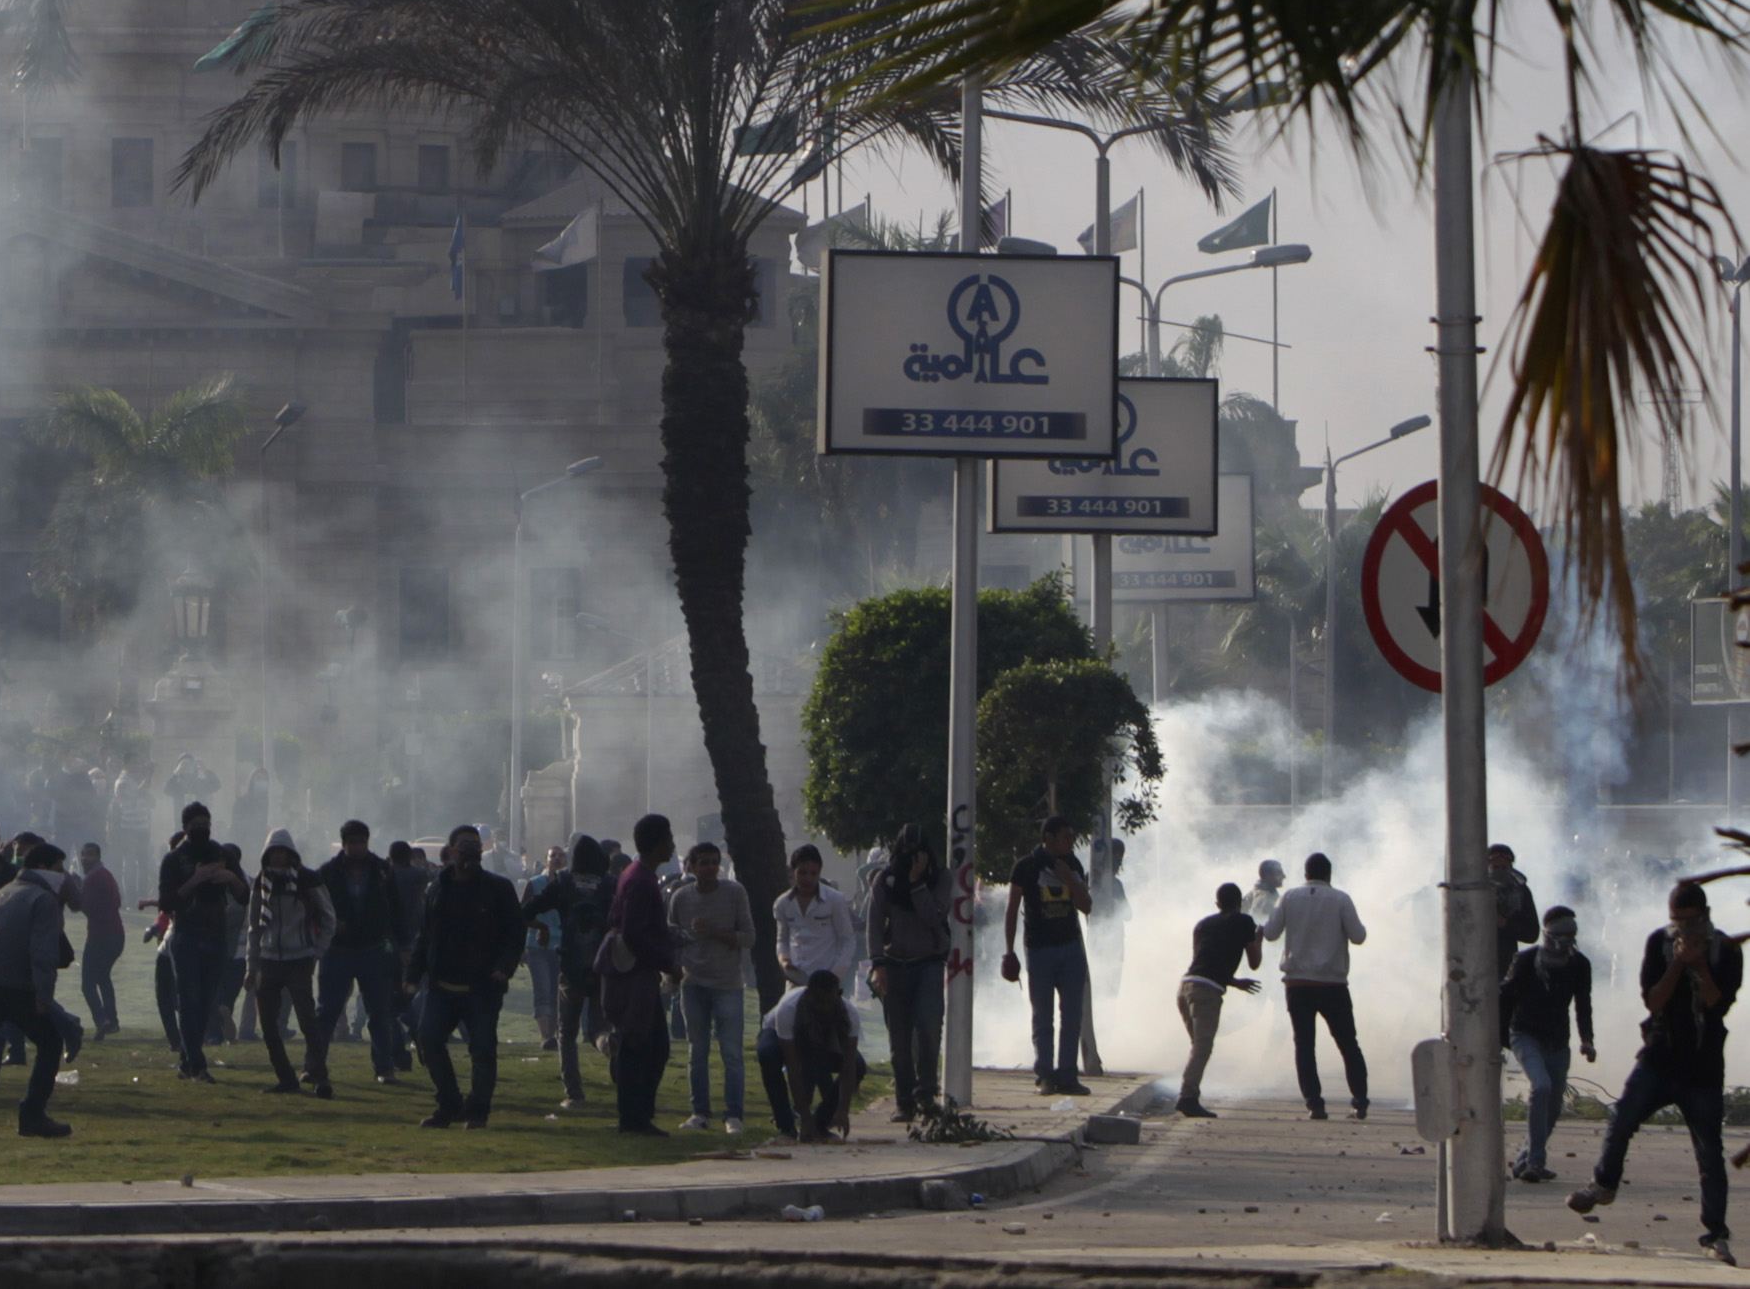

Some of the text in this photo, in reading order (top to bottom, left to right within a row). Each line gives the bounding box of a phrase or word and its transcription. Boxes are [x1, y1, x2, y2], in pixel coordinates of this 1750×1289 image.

[901, 413, 1050, 434] 33 444 901
[1047, 498, 1162, 515] 33 444 901
[1120, 573, 1213, 587] 33 444 901
